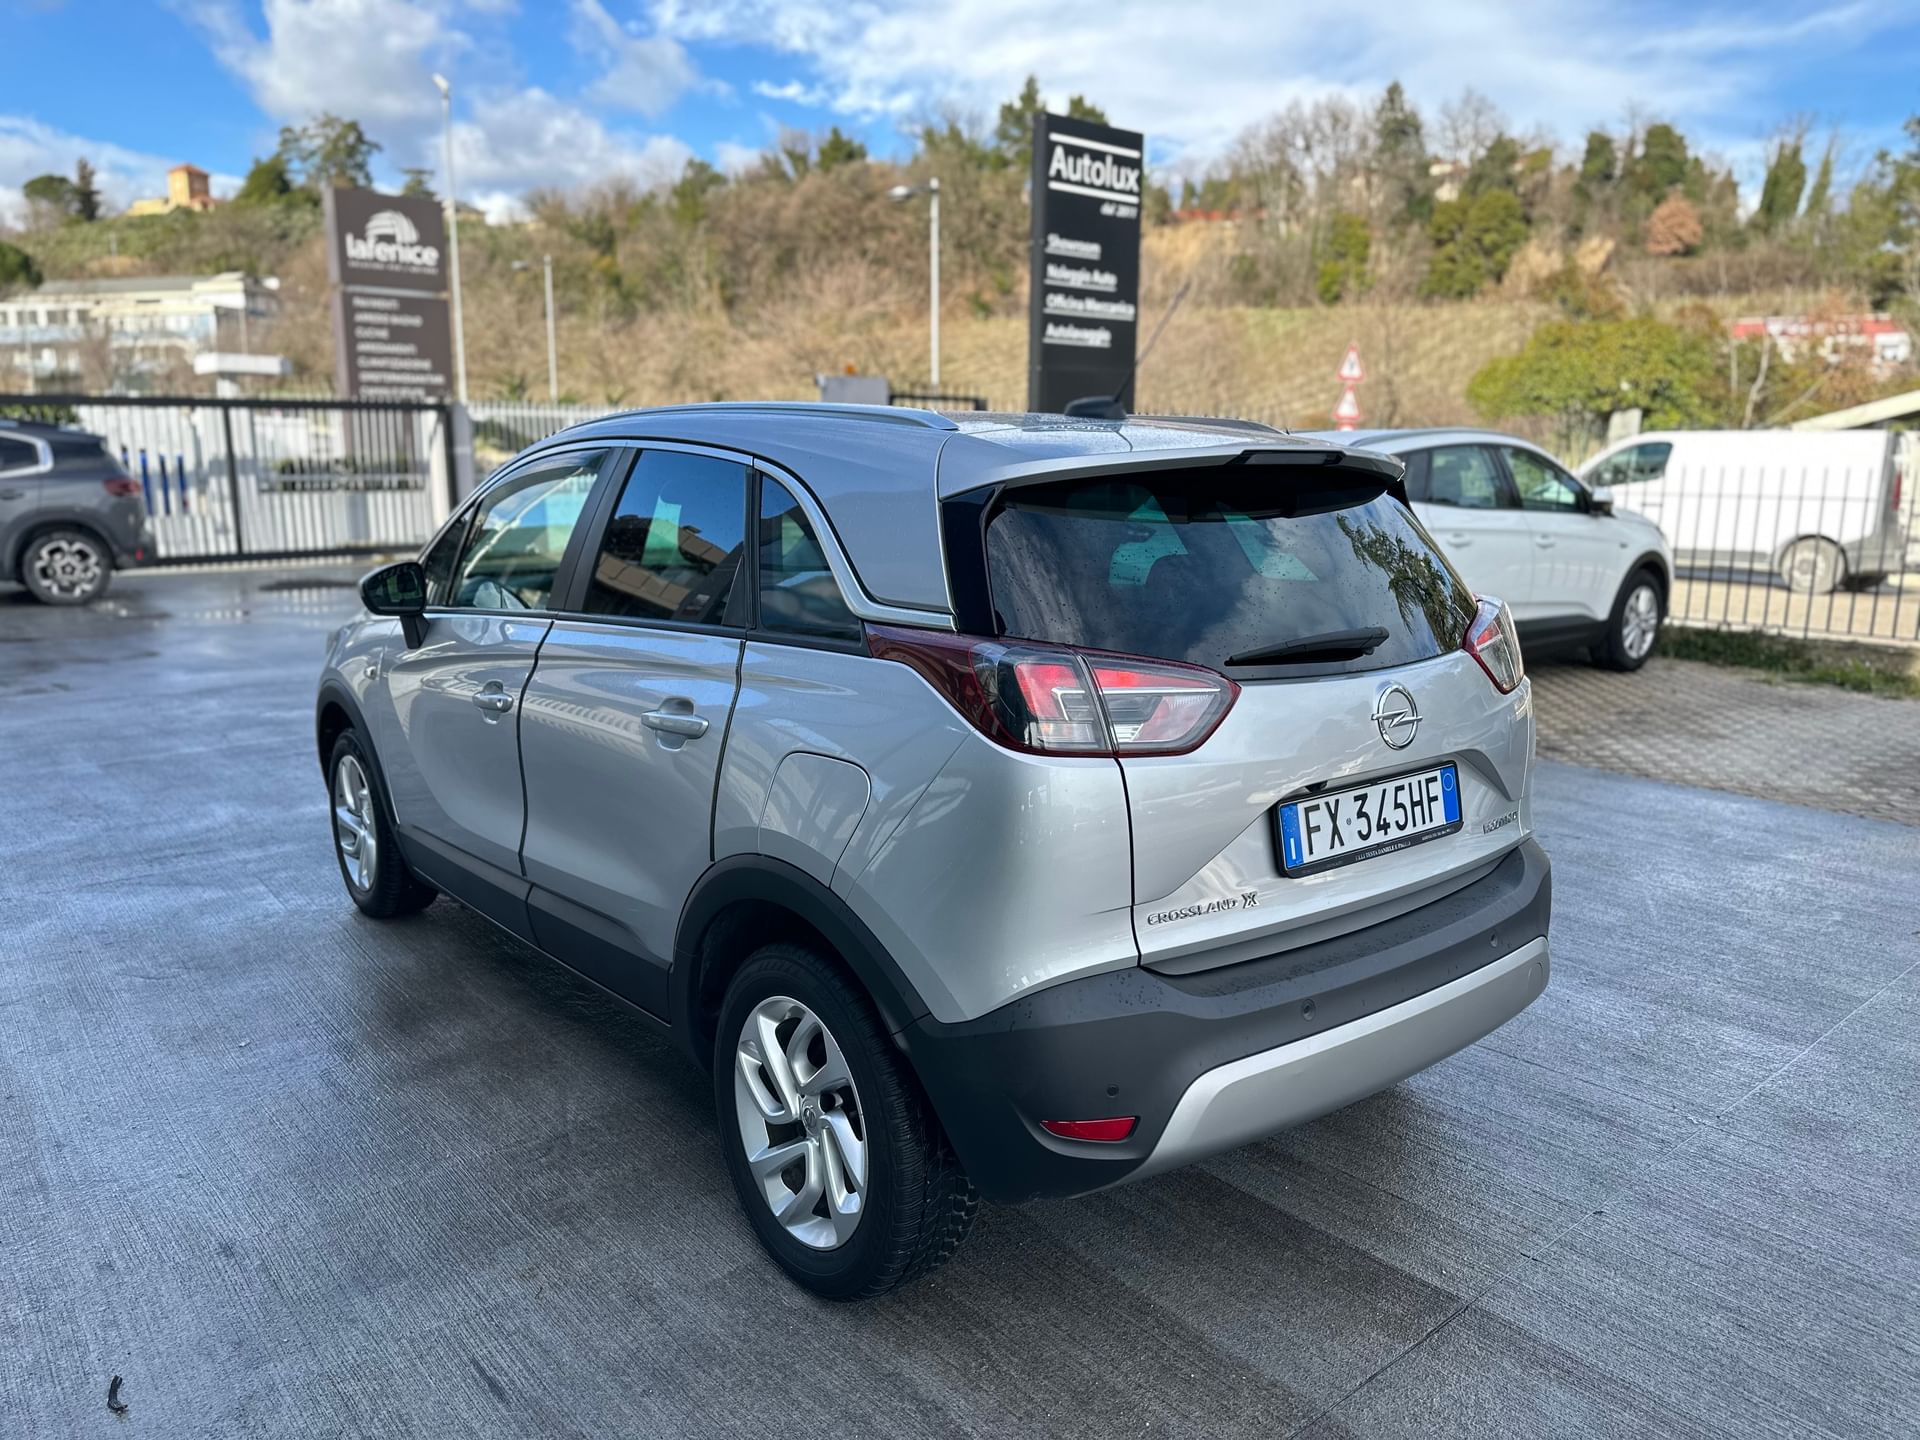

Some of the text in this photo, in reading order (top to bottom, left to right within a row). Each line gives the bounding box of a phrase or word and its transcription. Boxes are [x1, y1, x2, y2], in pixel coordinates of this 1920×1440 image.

[1050, 145, 1140, 193] Autolux
[1304, 775, 1439, 856] FX 345HF
[1147, 891, 1259, 926] CROSSLAND X
